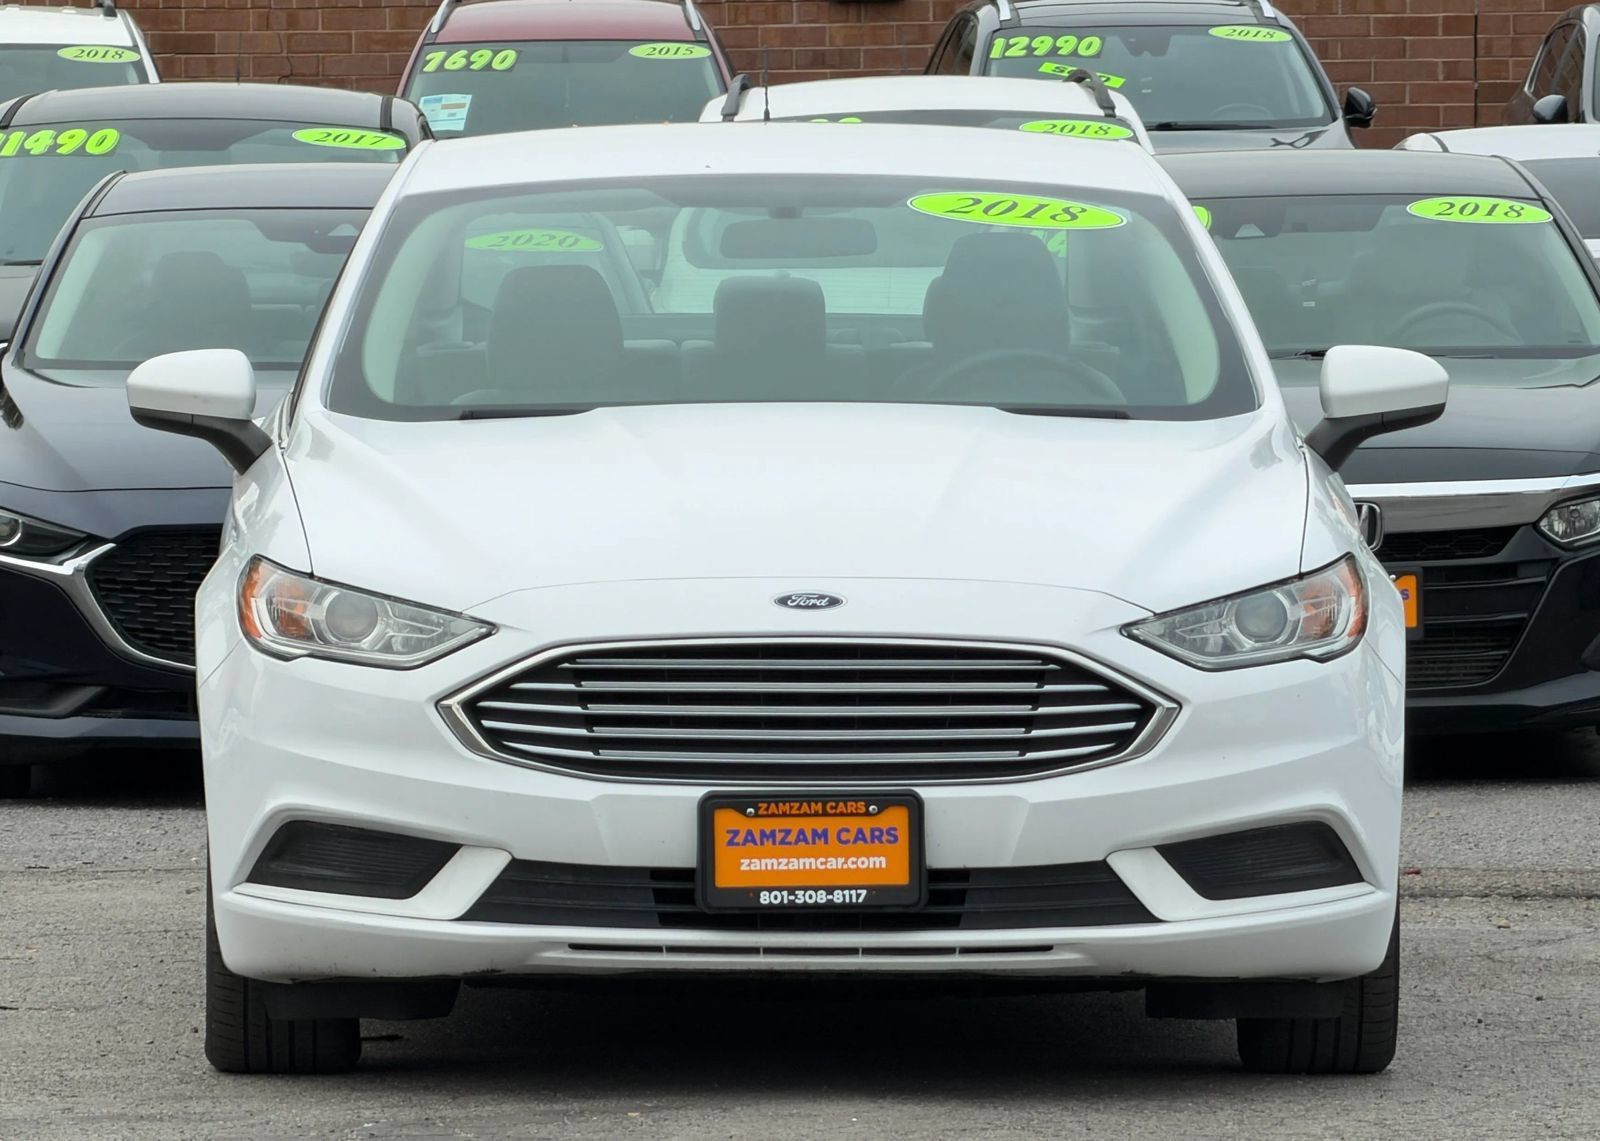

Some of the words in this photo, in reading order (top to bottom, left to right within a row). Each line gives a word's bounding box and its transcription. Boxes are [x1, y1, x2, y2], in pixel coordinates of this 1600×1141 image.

[1225, 28, 1276, 39] 2018
[73, 48, 125, 59] 2018
[644, 46, 695, 56] 2015
[989, 35, 1102, 58] 12990
[422, 49, 517, 72] 7690
[1042, 122, 1111, 136] 2018
[0, 128, 120, 156] 1490
[314, 131, 387, 145] 2017
[944, 197, 1087, 223] 2018
[1435, 201, 1525, 219] 2018
[488, 233, 580, 248] 2020
[787, 594, 830, 606] Ford
[758, 802, 822, 815] ZAMZAM
[826, 801, 866, 814] CARS
[725, 828, 829, 847] ZAMZAM
[836, 826, 899, 844] CARS
[740, 855, 887, 871] zamzamcar.com
[759, 889, 867, 904] 801-308-8117
